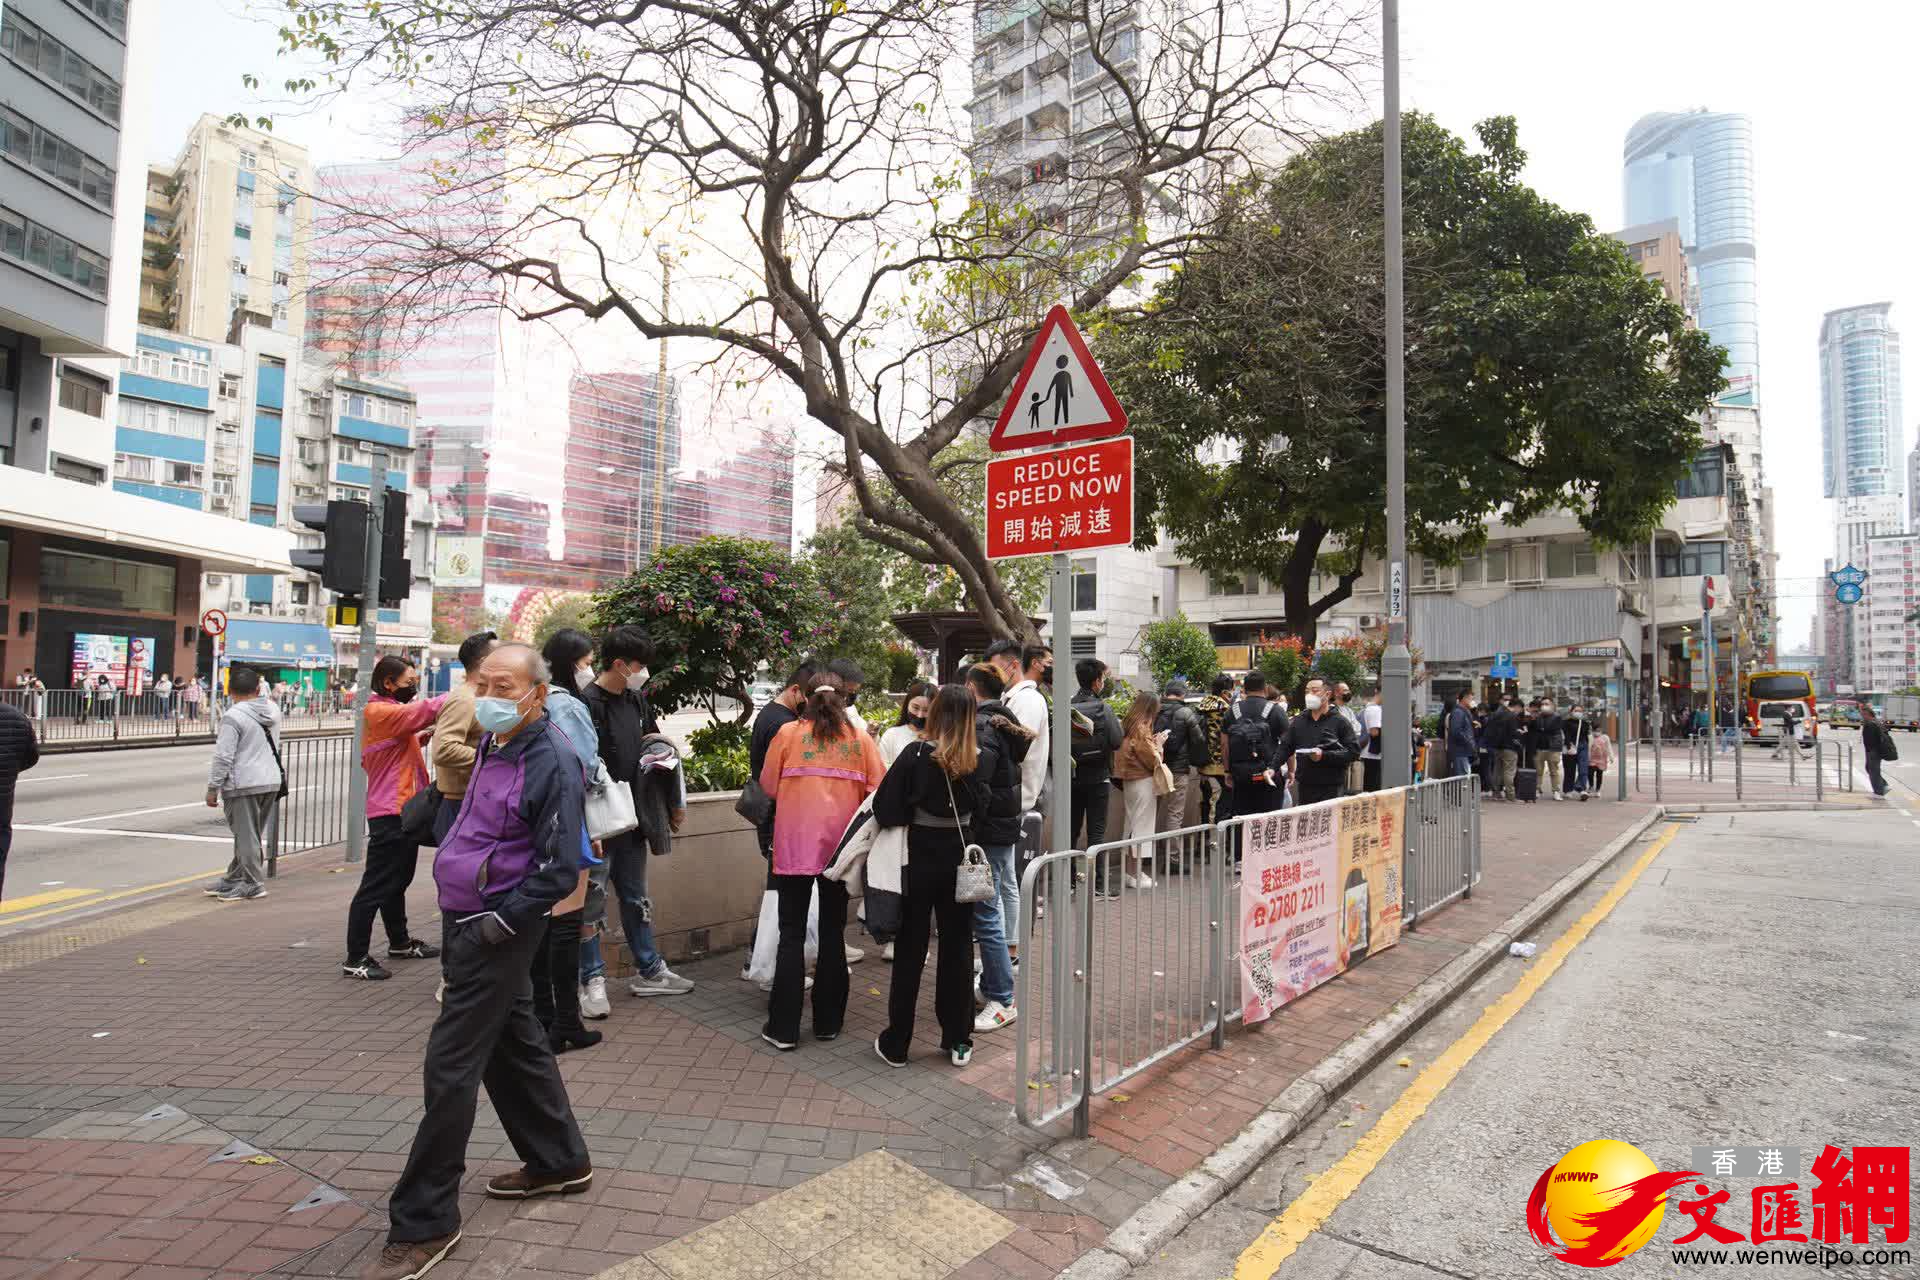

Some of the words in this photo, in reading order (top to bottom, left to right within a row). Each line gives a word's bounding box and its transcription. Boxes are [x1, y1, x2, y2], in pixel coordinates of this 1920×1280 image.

[1013, 453, 1101, 484] REDUCE
[995, 482, 1062, 510] SPEED
[1069, 473, 1122, 501] NOW
[1003, 506, 1112, 544] 開始減速
[1392, 588, 1400, 616] 9737
[1498, 654, 1508, 666] P
[1269, 892, 1298, 924] 2780
[1300, 881, 1326, 914] 2211
